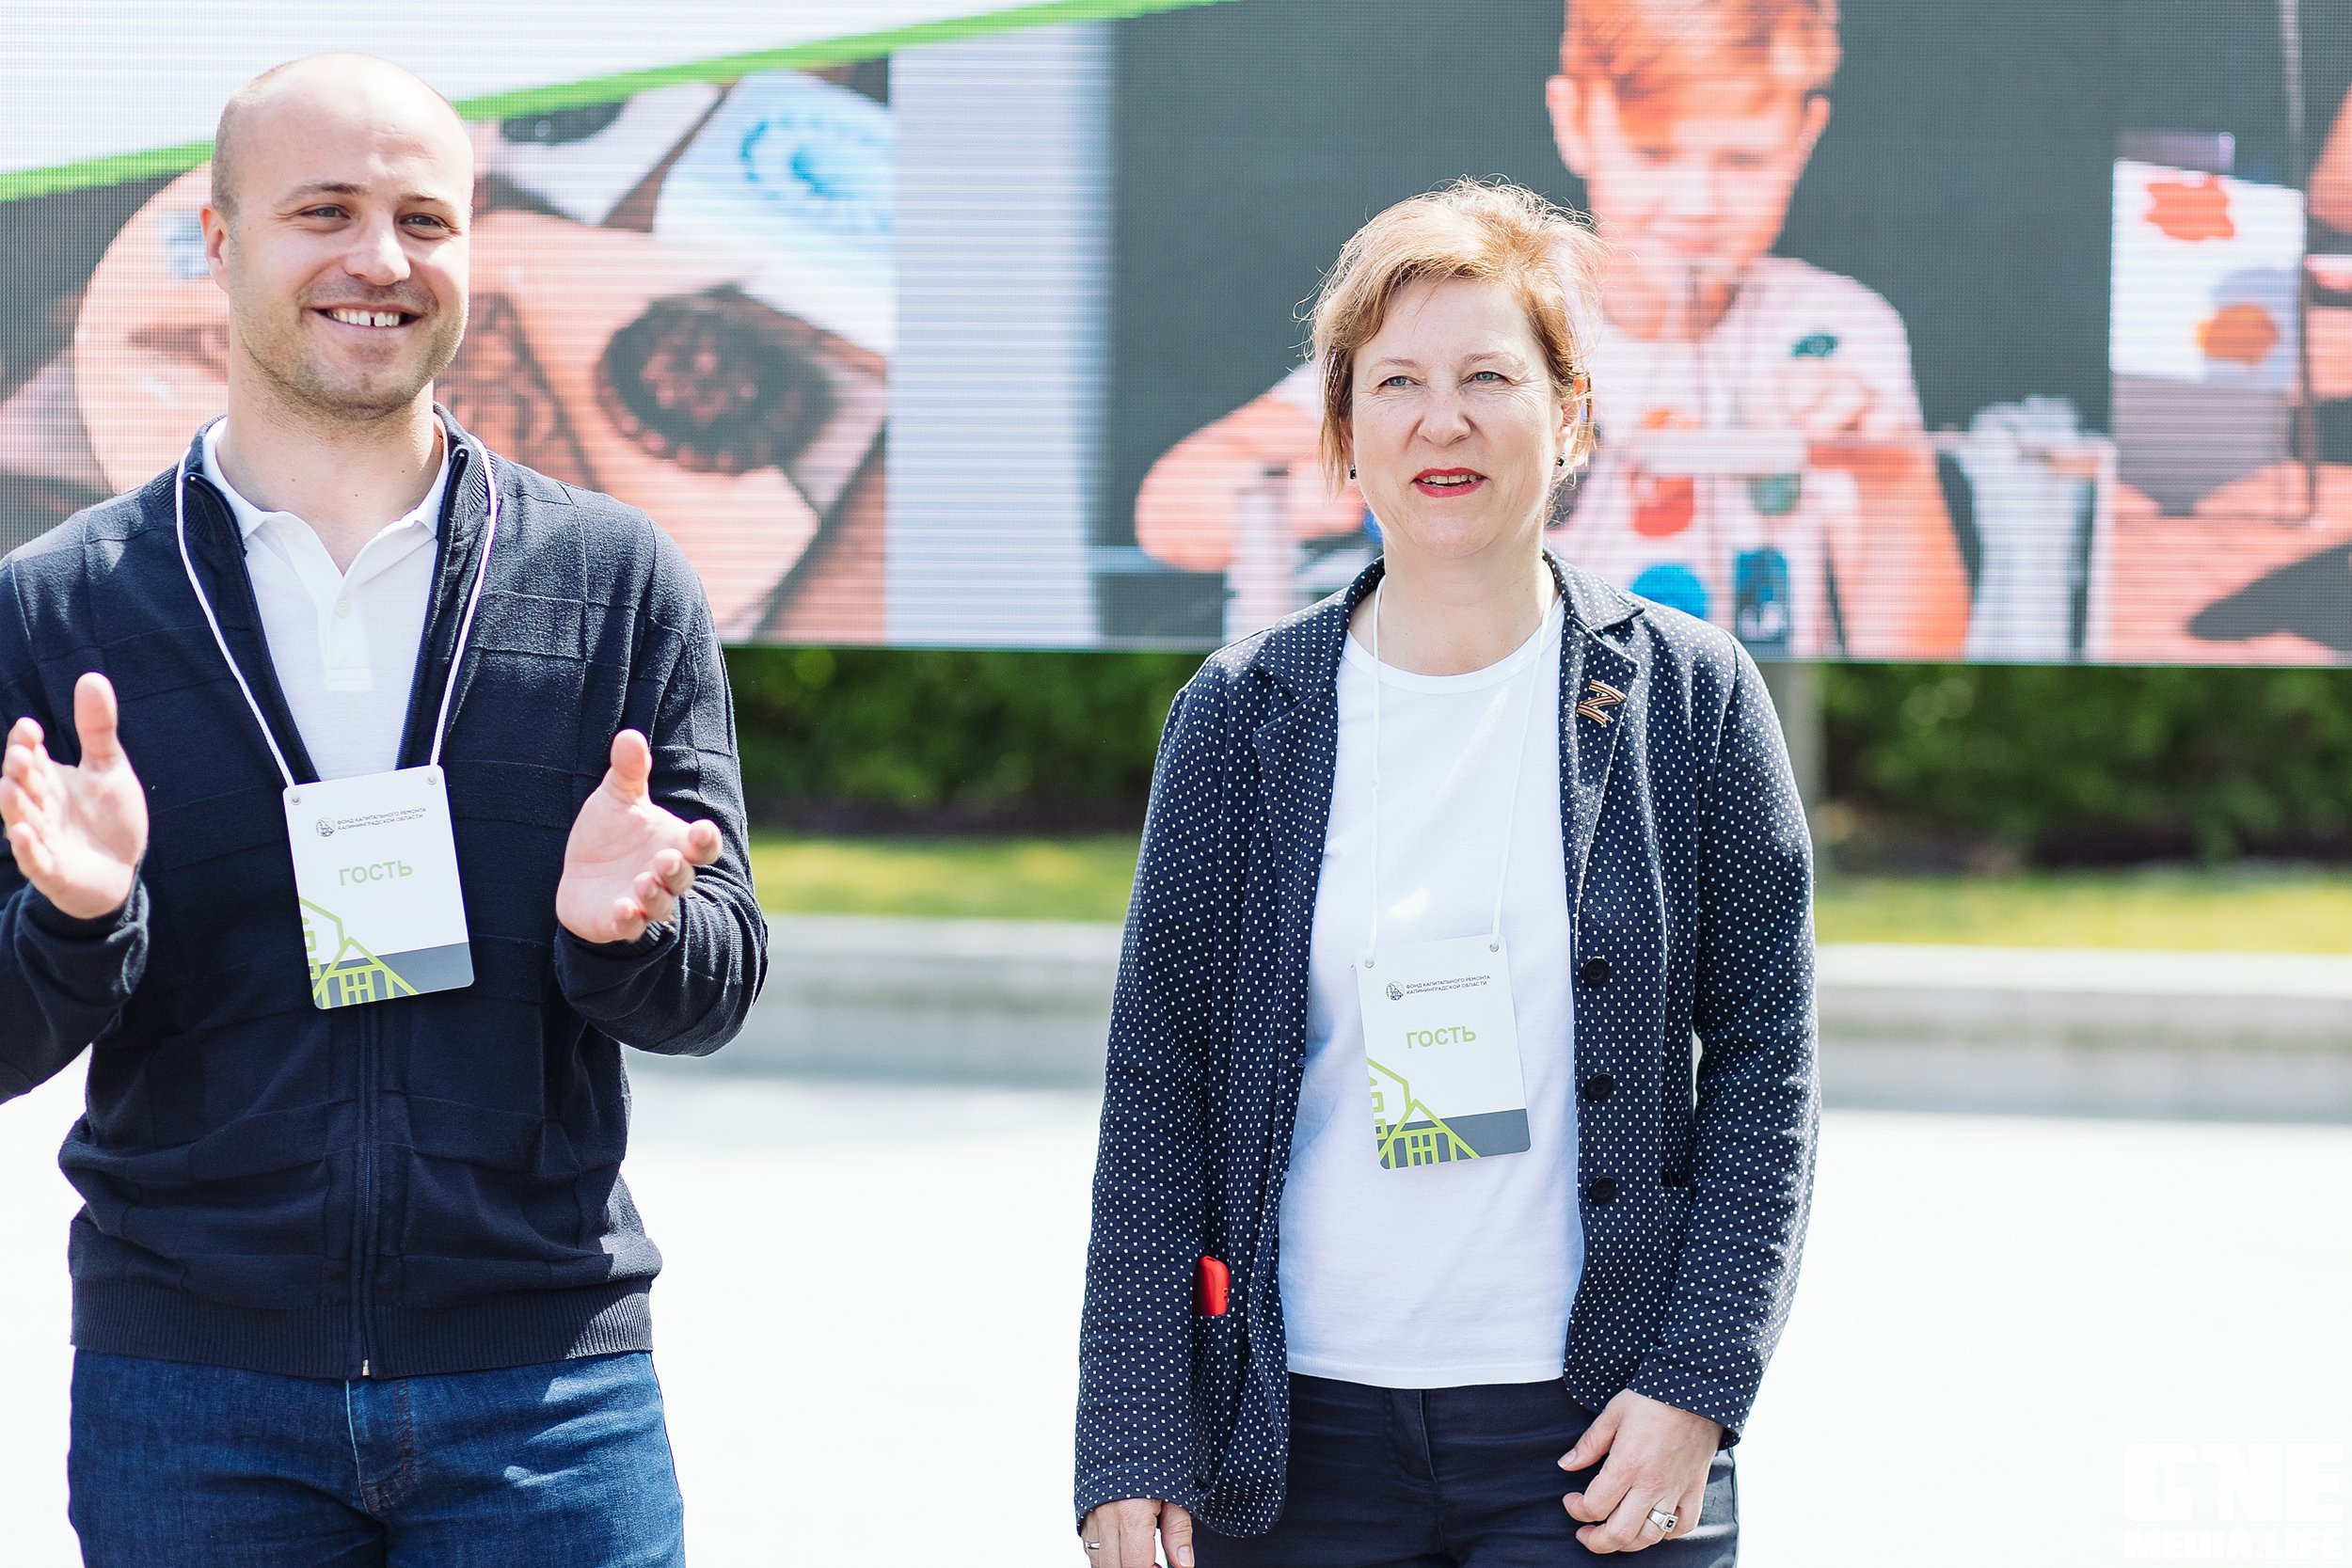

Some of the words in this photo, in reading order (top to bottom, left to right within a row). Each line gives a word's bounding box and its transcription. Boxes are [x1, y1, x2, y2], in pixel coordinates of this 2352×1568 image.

[355, 812, 400, 822] КАПИТАЛЬНОГО
[396, 814, 423, 822] ОБЛАСТИ
[339, 860, 413, 886] ГОСТЬ
[1422, 978, 1465, 987] КАПИТАЛЬНОГО
[1406, 1025, 1477, 1050] ГОСТЬ
